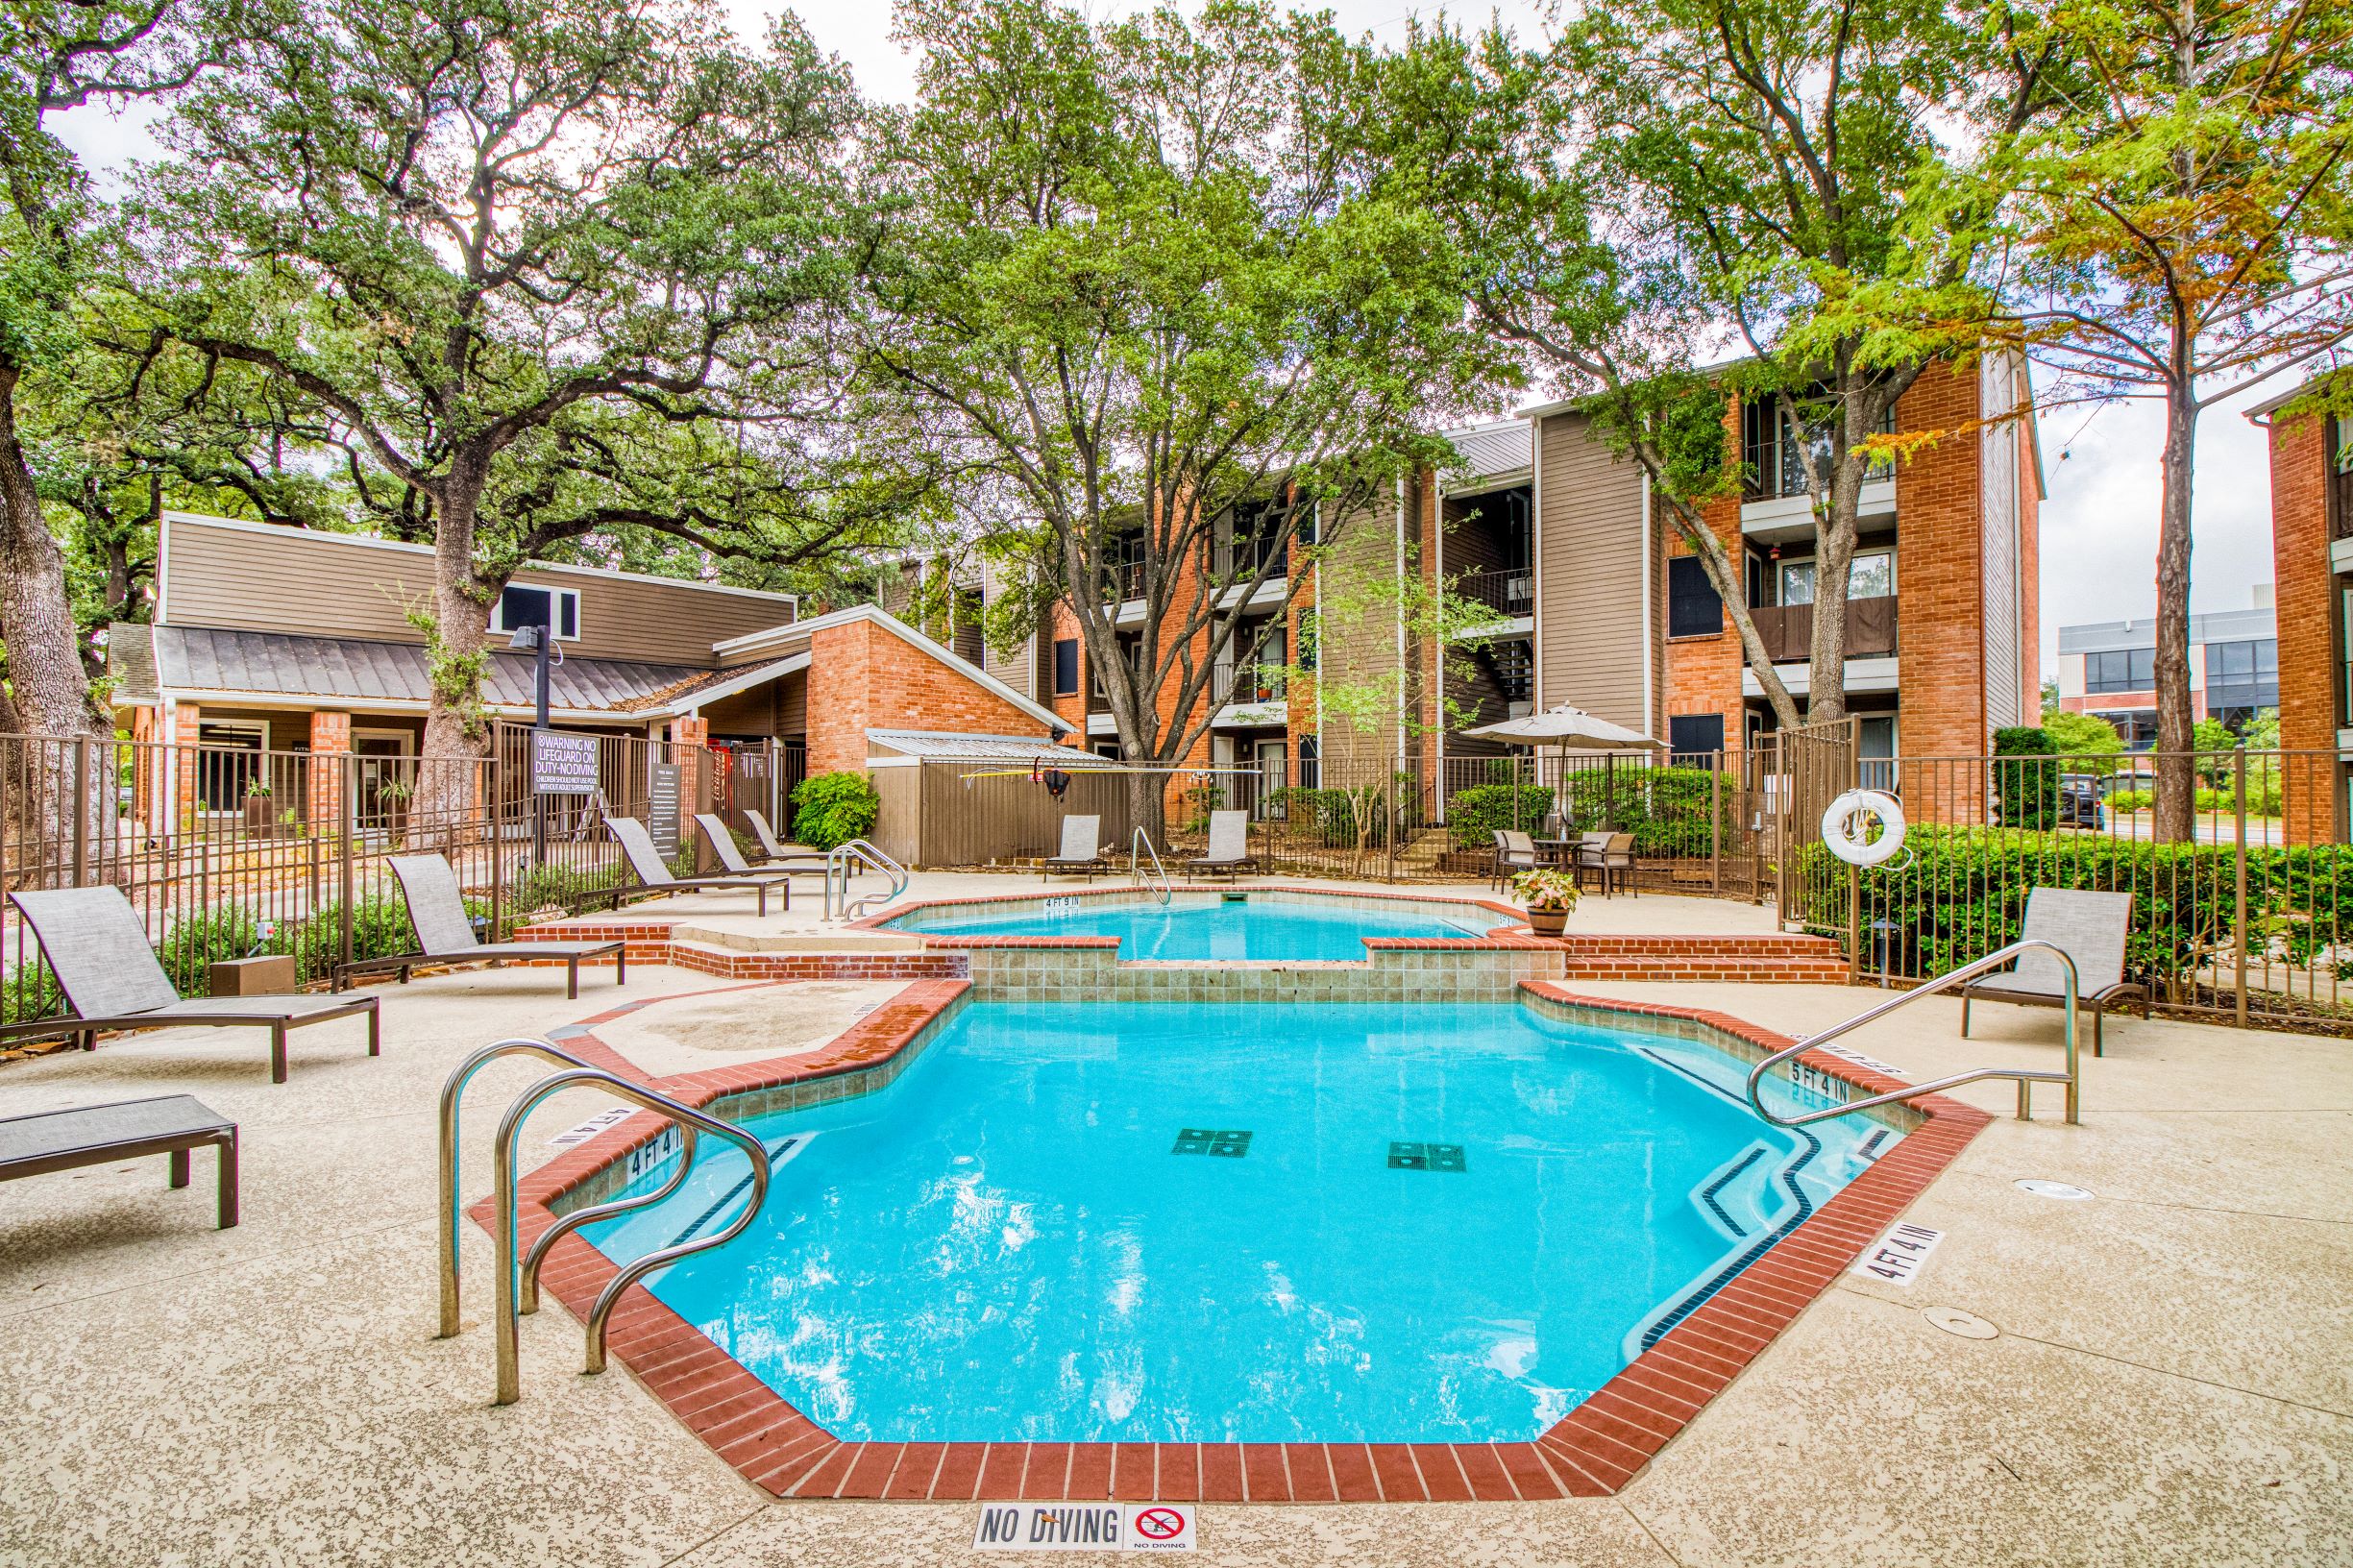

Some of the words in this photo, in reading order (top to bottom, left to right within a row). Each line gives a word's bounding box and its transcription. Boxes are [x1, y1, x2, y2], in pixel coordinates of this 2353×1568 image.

[545, 736, 583, 750] WARNING
[584, 740, 597, 751] NO
[539, 748, 581, 763] LIFEGUARD
[582, 751, 595, 764] ON
[573, 764, 599, 775] DIVING
[1046, 898, 1051, 907] 4
[1054, 897, 1062, 907] FT
[1065, 897, 1069, 906] 9
[1072, 896, 1079, 905] IN
[1792, 1062, 1800, 1082] 5
[1803, 1066, 1816, 1090] FT
[1821, 1075, 1829, 1095] 4
[1835, 1079, 1847, 1103] IN
[631, 1150, 641, 1177] 4
[645, 1138, 658, 1170] FT
[663, 1130, 671, 1155] 4
[1897, 1224, 1938, 1241] IN
[1889, 1238, 1926, 1251] 4
[1874, 1248, 1918, 1270] FT
[1867, 1264, 1905, 1279] 4
[980, 1508, 1019, 1543] NO
[1029, 1508, 1118, 1543] DIVING
